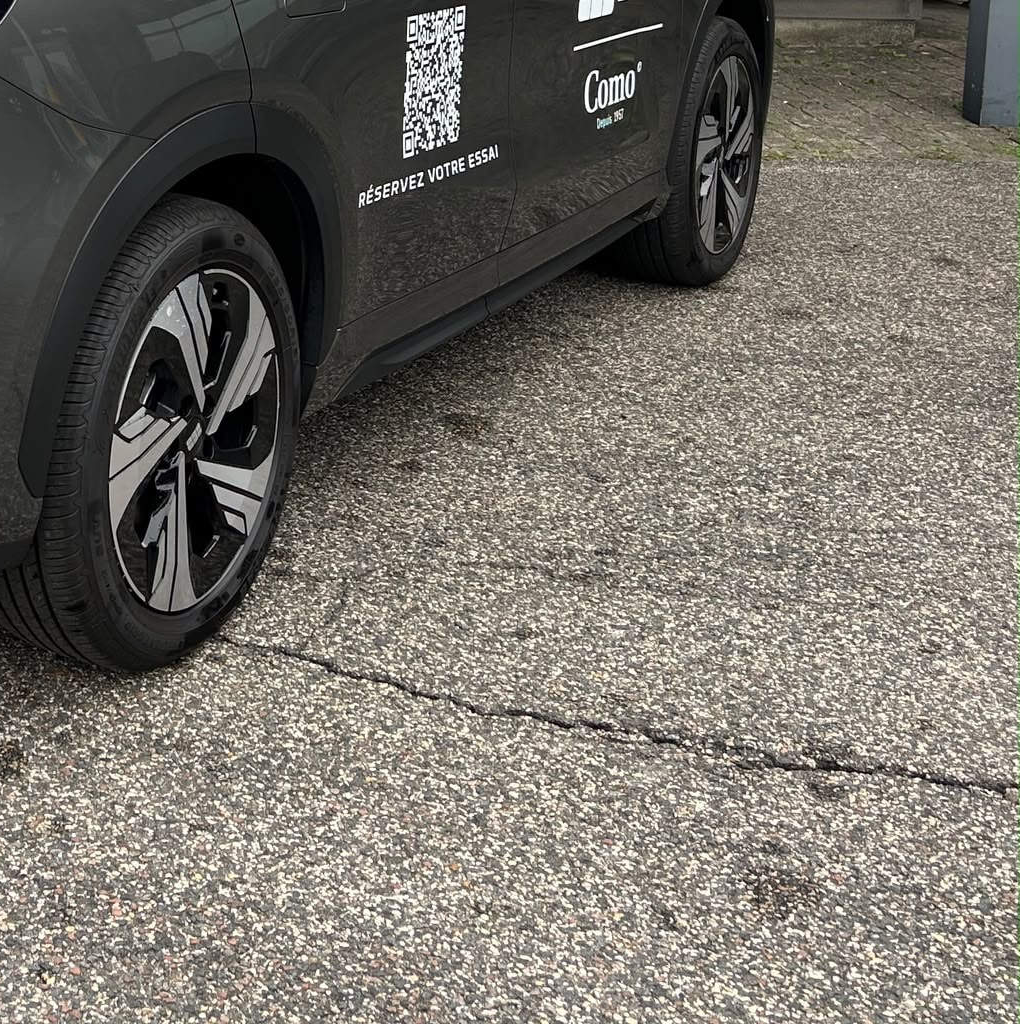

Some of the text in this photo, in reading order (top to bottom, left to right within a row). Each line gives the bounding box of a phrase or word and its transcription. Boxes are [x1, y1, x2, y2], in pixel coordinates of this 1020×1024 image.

[358, 144, 499, 208] RÉSERVEZ VOTRE ESSAI
